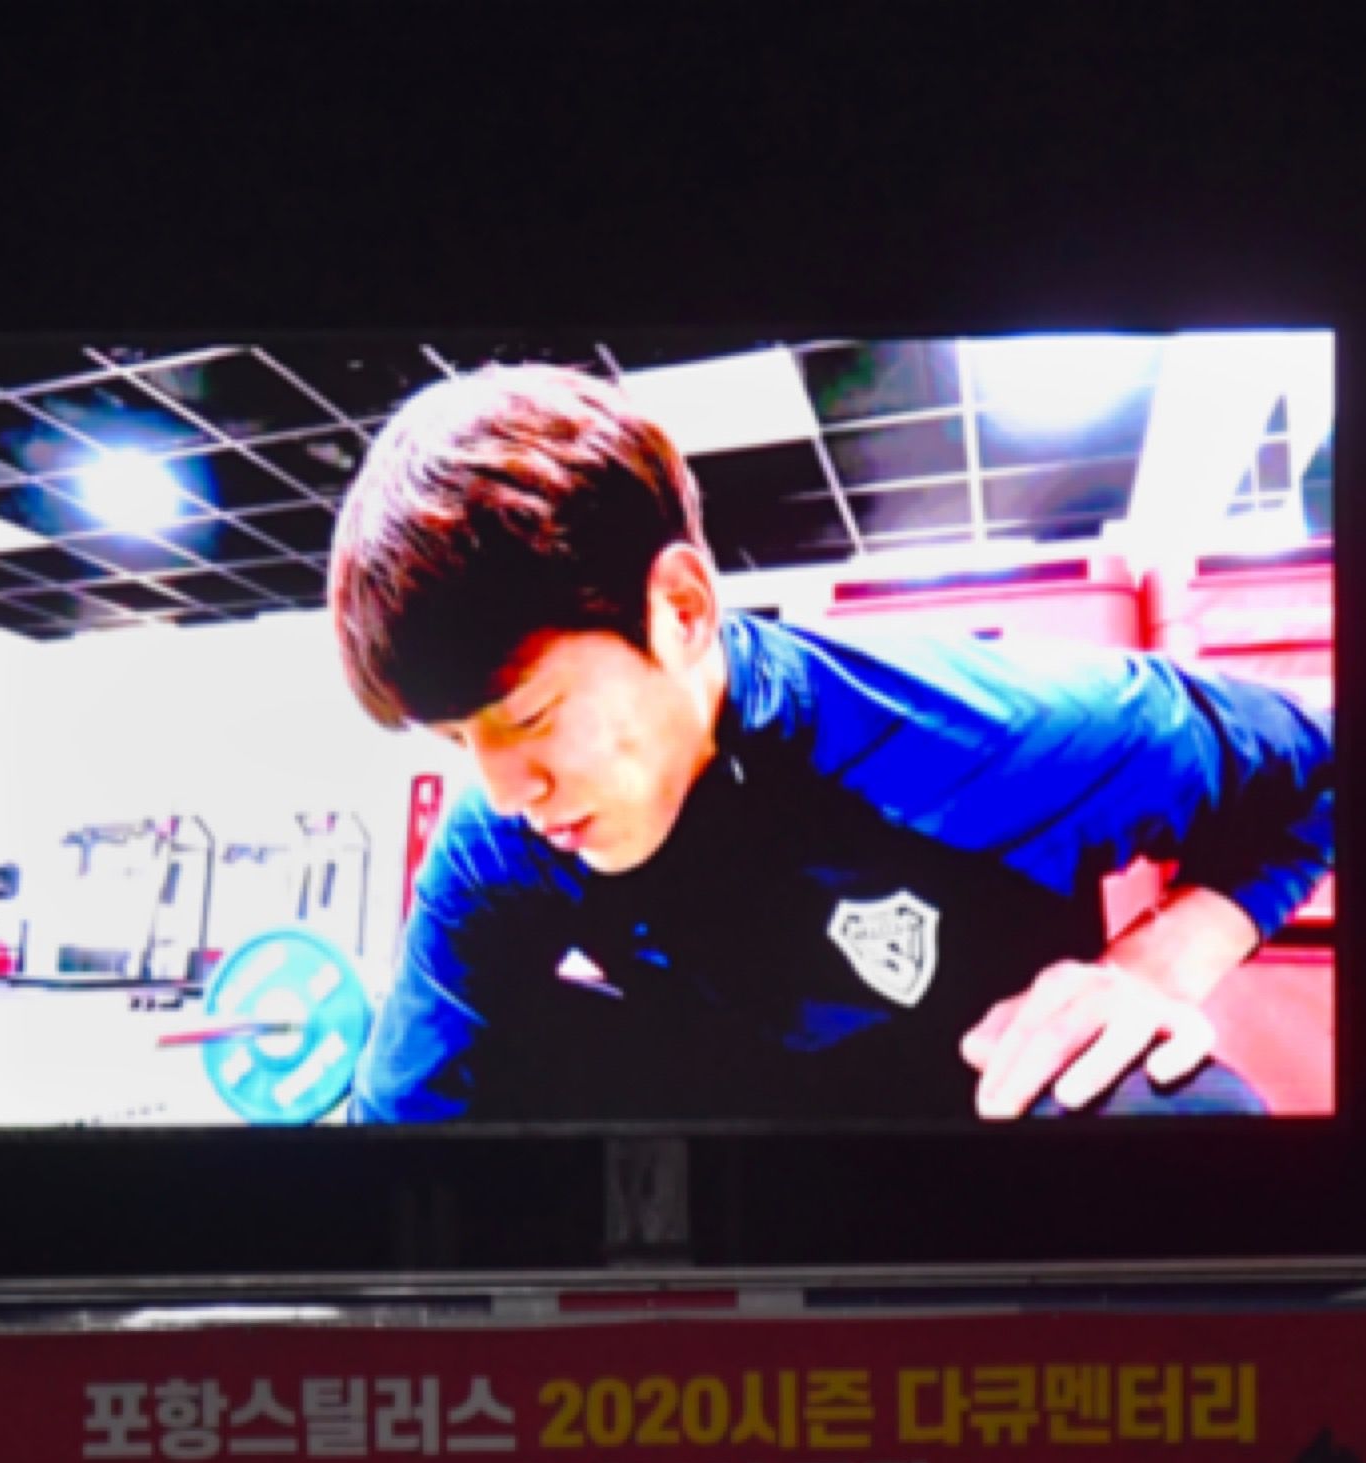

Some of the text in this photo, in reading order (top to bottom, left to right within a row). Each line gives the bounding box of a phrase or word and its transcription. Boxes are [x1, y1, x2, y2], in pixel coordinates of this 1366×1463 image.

[82, 1363, 1258, 1461] 포항스틸러스 2020시즌 다큐멘터리
